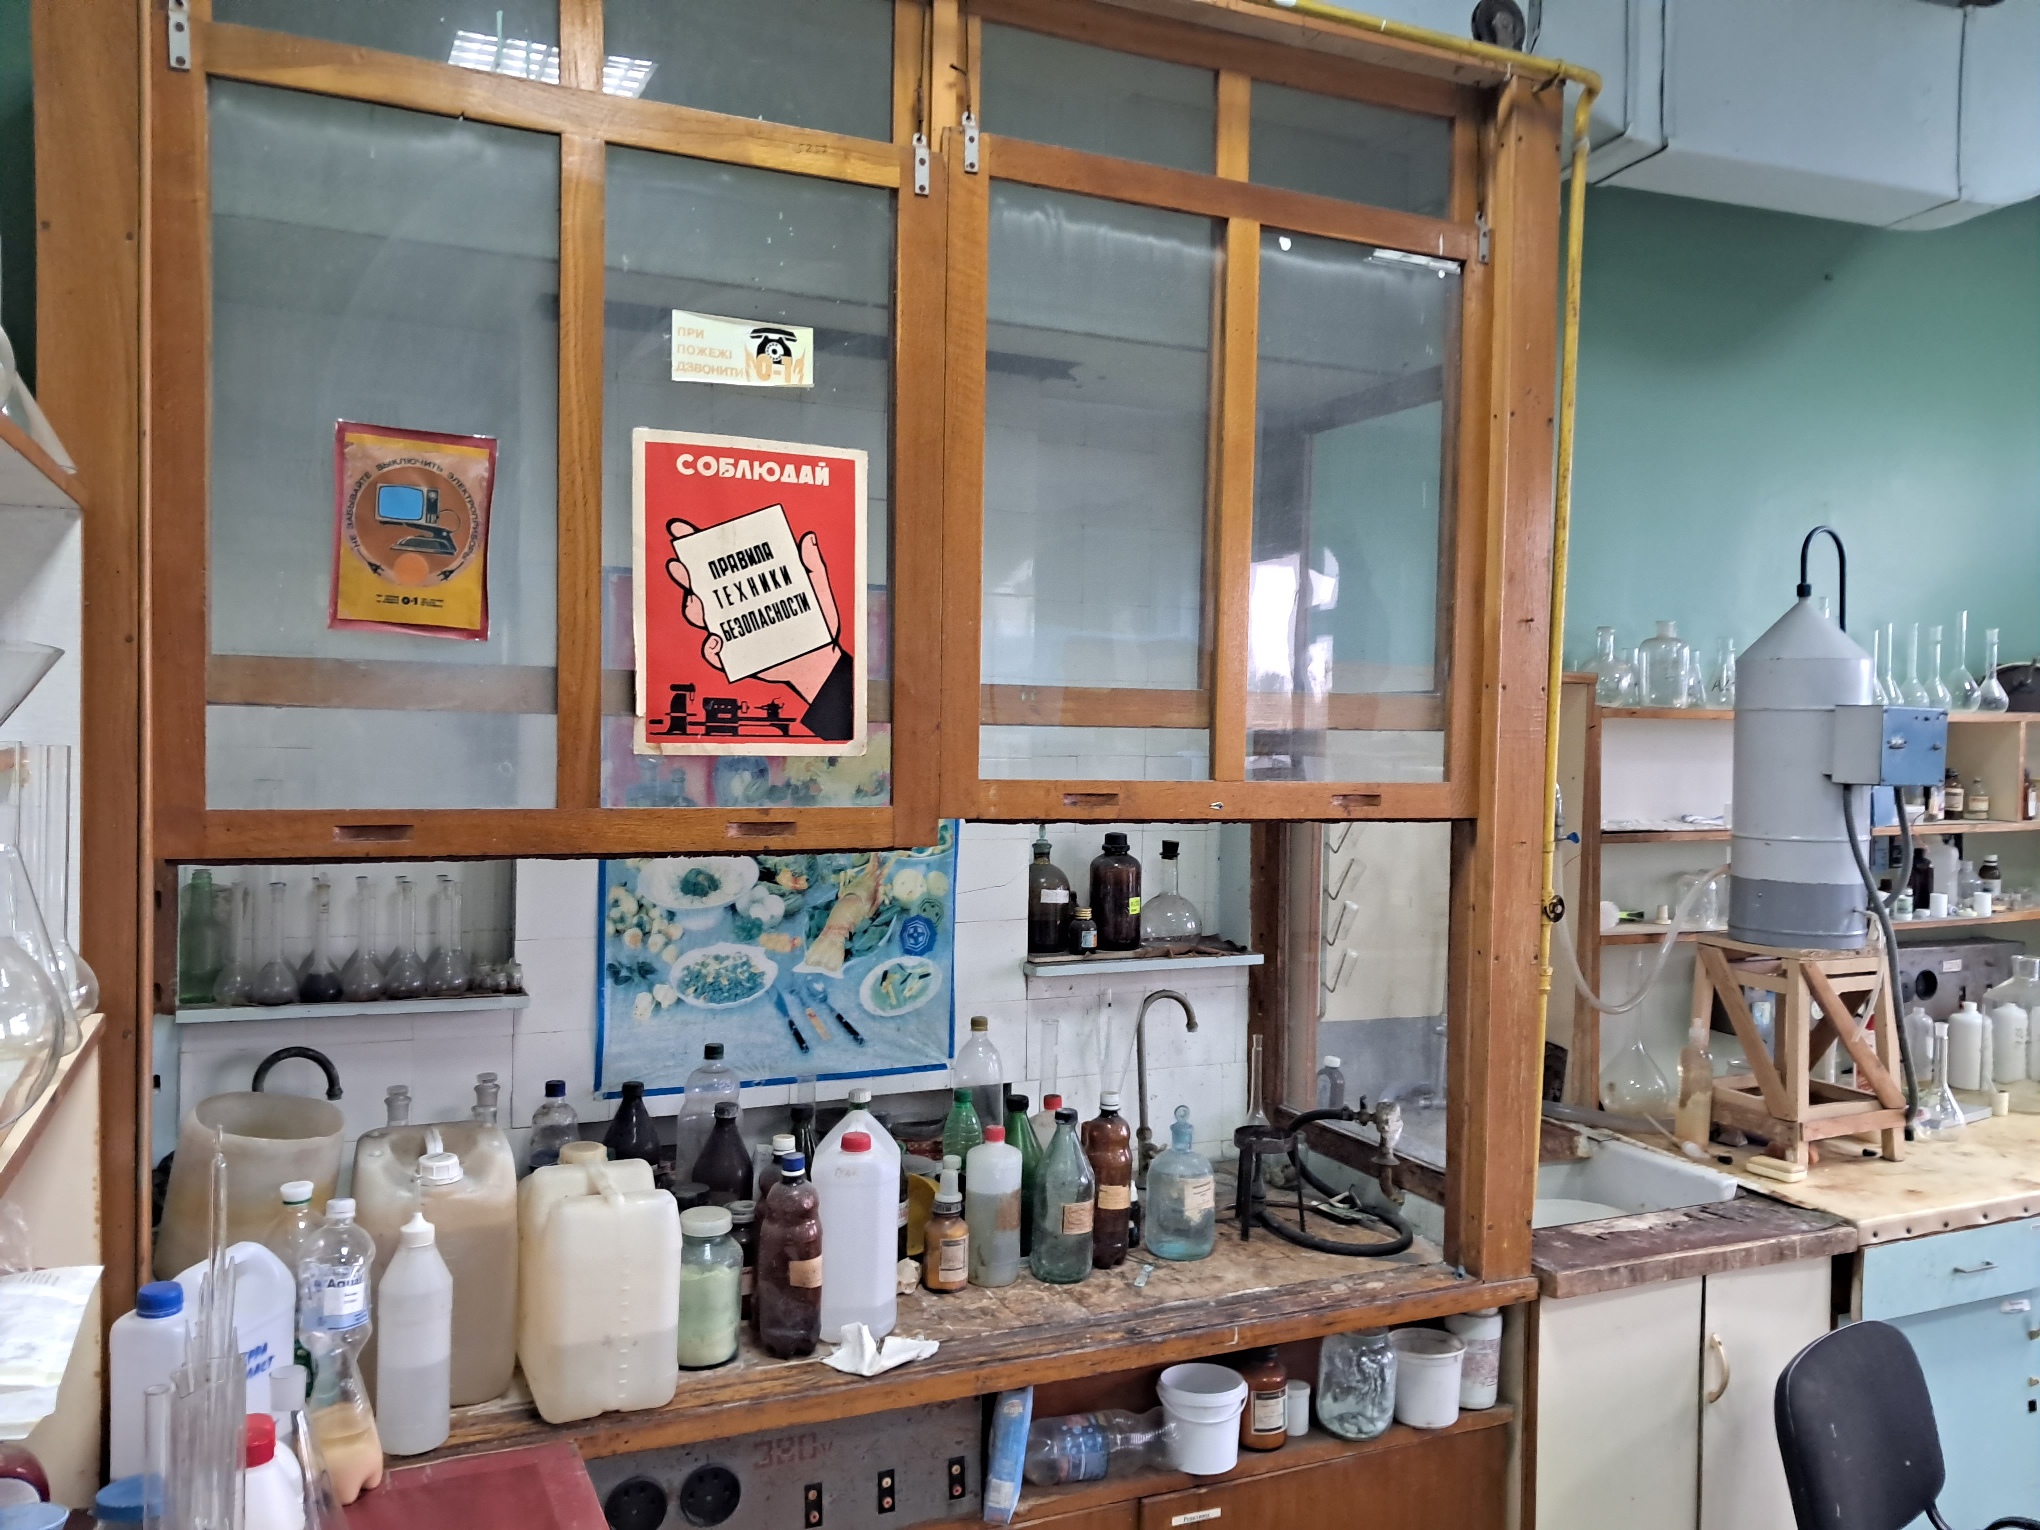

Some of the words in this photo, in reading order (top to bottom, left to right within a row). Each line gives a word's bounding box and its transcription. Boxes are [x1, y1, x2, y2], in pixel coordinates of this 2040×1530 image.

[677, 326, 705, 340] ПРИ
[677, 344, 733, 360] ПОЖЕЖІ
[676, 361, 744, 378] ДЗВОНИТИ
[375, 458, 443, 472] ВЫКЛЮЧИТЬ
[676, 453, 830, 487] СОБЛЮДАЙ
[346, 471, 373, 530] ЗАБЫВАЙТЕ
[447, 471, 480, 559] ЭЛЕКТРОПРИБОРЫ
[349, 534, 360, 548] НЕ
[708, 541, 774, 580] ПРАВИЛА
[712, 565, 793, 609] ТЕХНИКИ
[719, 592, 811, 642] БЕЗОПАСНОСТИ
